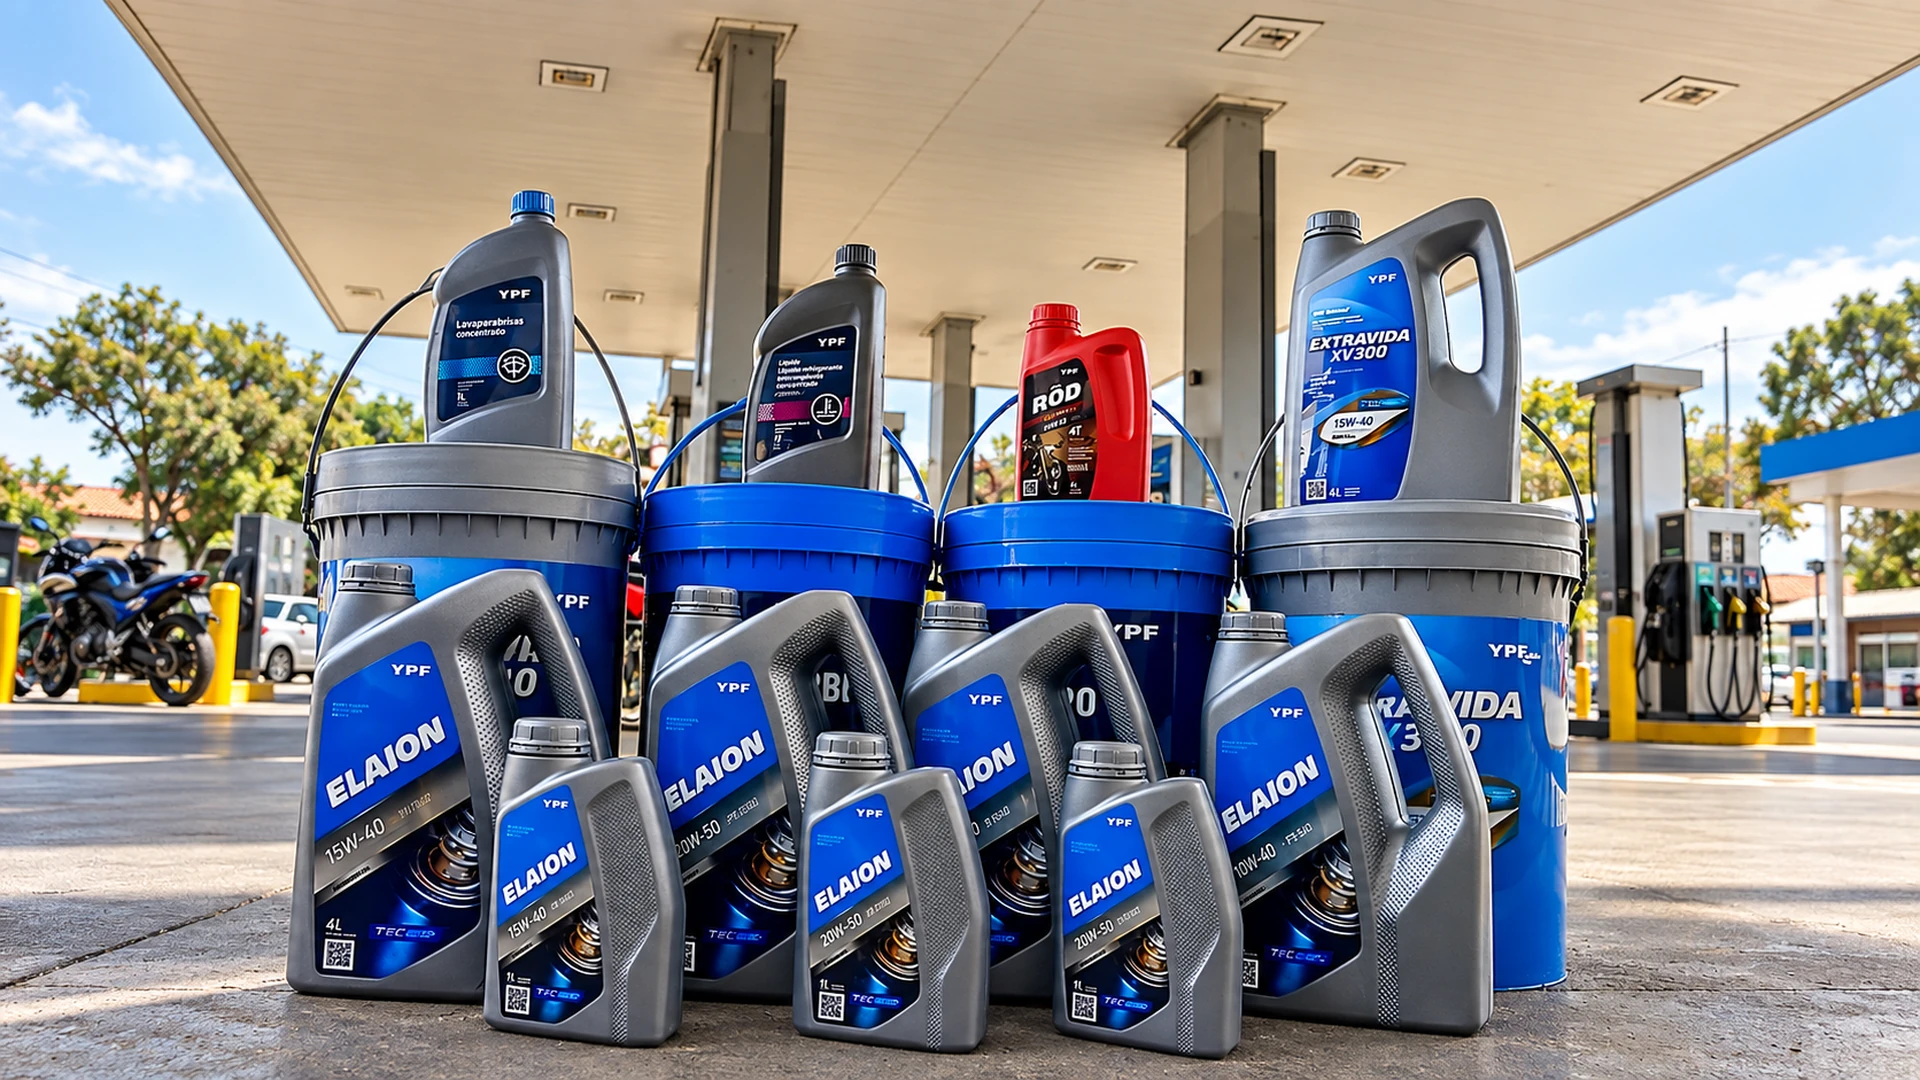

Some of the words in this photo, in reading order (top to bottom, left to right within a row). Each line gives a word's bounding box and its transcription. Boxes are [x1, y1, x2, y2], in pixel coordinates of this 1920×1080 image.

[1368, 273, 1397, 284] YPF
[499, 289, 531, 299] YPF
[818, 337, 846, 347] YPF
[1309, 328, 1410, 353] EXTRAVIDA
[1330, 345, 1388, 362] XV300
[1334, 416, 1374, 428] 15W-40
[1328, 487, 1342, 497] 4L
[1488, 643, 1528, 660] YPF
[391, 664, 431, 676] YPF
[717, 682, 750, 693] YPF
[969, 694, 1002, 705] YPF
[1270, 707, 1304, 718] YPF
[325, 715, 446, 808] ELAION
[663, 729, 765, 812] ELAION
[1221, 754, 1320, 834] ELAION
[543, 799, 569, 809] YPF
[856, 808, 884, 818] YPF
[1107, 817, 1132, 827] YPF
[325, 817, 386, 865] 15W-40
[675, 819, 721, 858] 20W-50
[1234, 843, 1276, 878] 10W-40
[502, 842, 577, 906] ELAION
[814, 850, 892, 913] ELAION
[1068, 859, 1142, 917] ELAION
[325, 918, 342, 931] 4L
[507, 906, 547, 939] 15W-40
[820, 912, 863, 948] 20W-50
[1074, 919, 1114, 950] 20W-50
[506, 972, 515, 982] 1L
[820, 978, 829, 990] 1L
[1073, 980, 1082, 991] 1L
